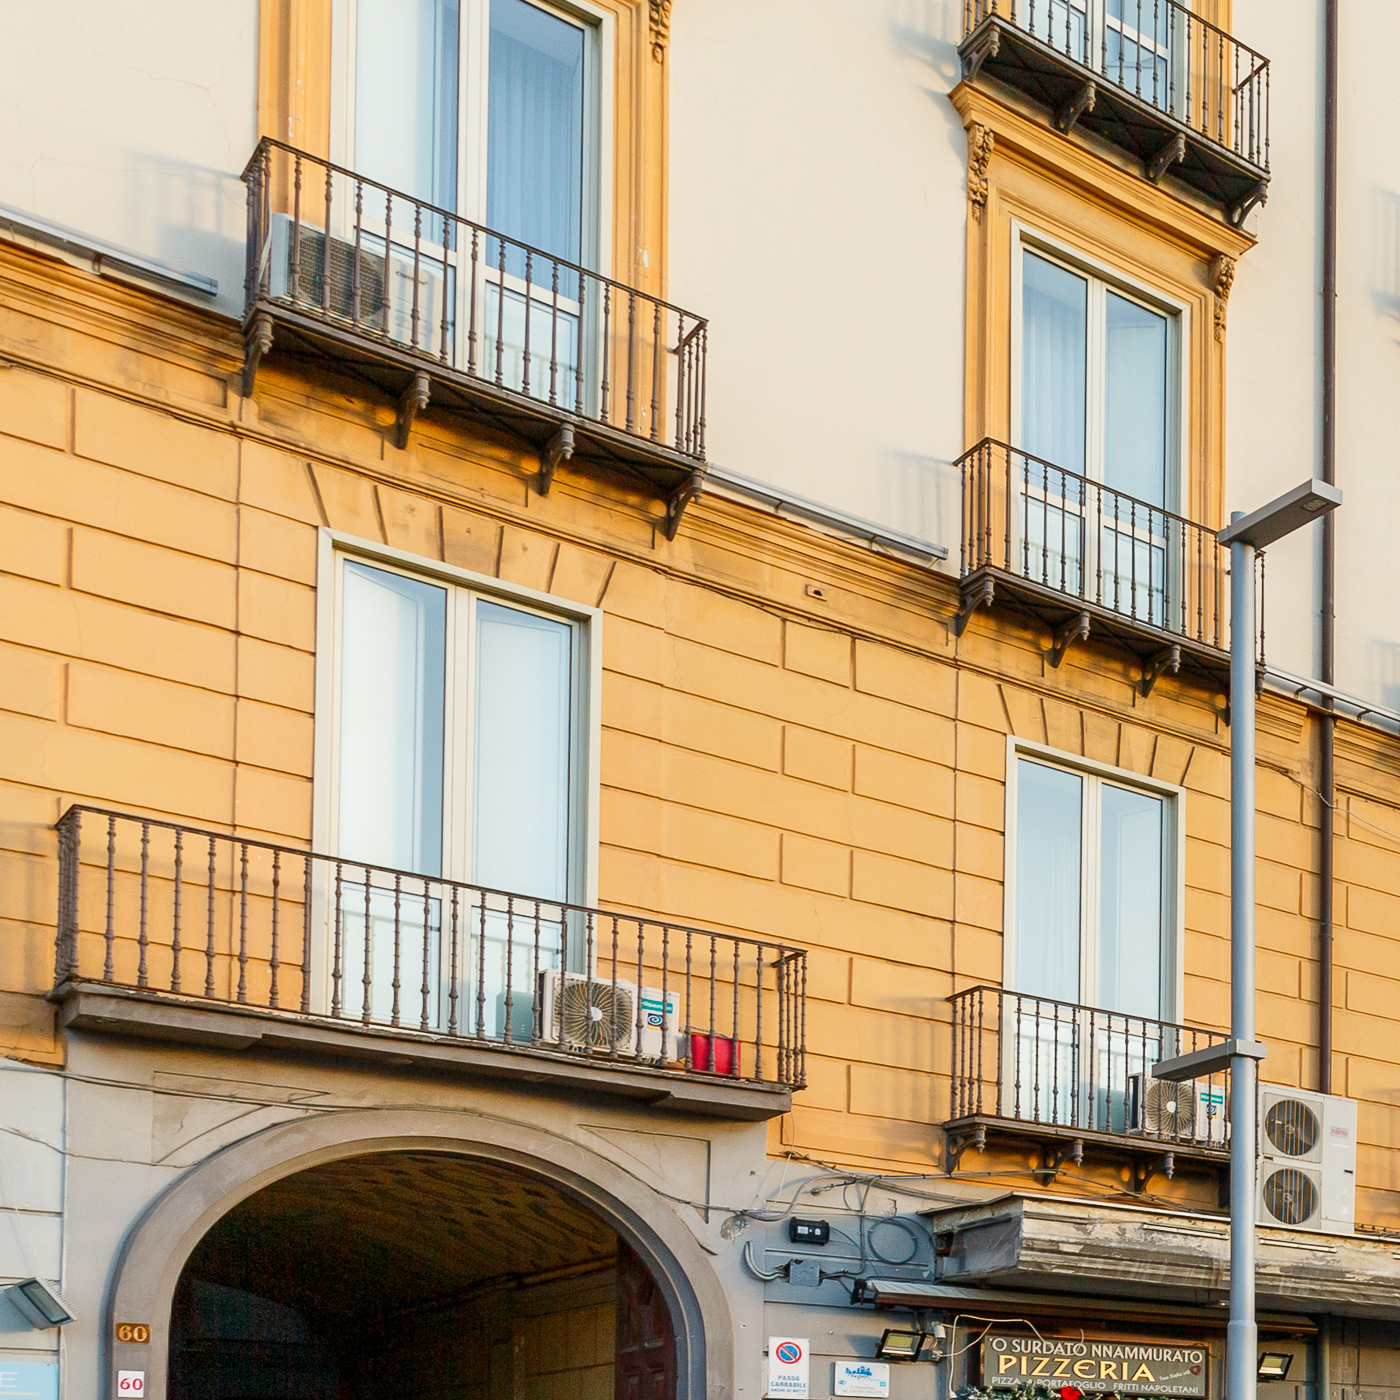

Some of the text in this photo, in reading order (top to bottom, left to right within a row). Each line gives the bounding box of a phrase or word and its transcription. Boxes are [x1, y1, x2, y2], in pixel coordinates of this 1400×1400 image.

[118, 1325, 148, 1343] 60
[1012, 1339, 1087, 1357] SURDATO
[1091, 1344, 1203, 1364] NNAMMURATO
[998, 1354, 1156, 1382] PIZZERIA
[119, 1377, 143, 1391] 60
[991, 1376, 1021, 1386] PIZZA
[1113, 1383, 1139, 1392] FRITTI
[1141, 1384, 1199, 1394] NAPOLETANI
